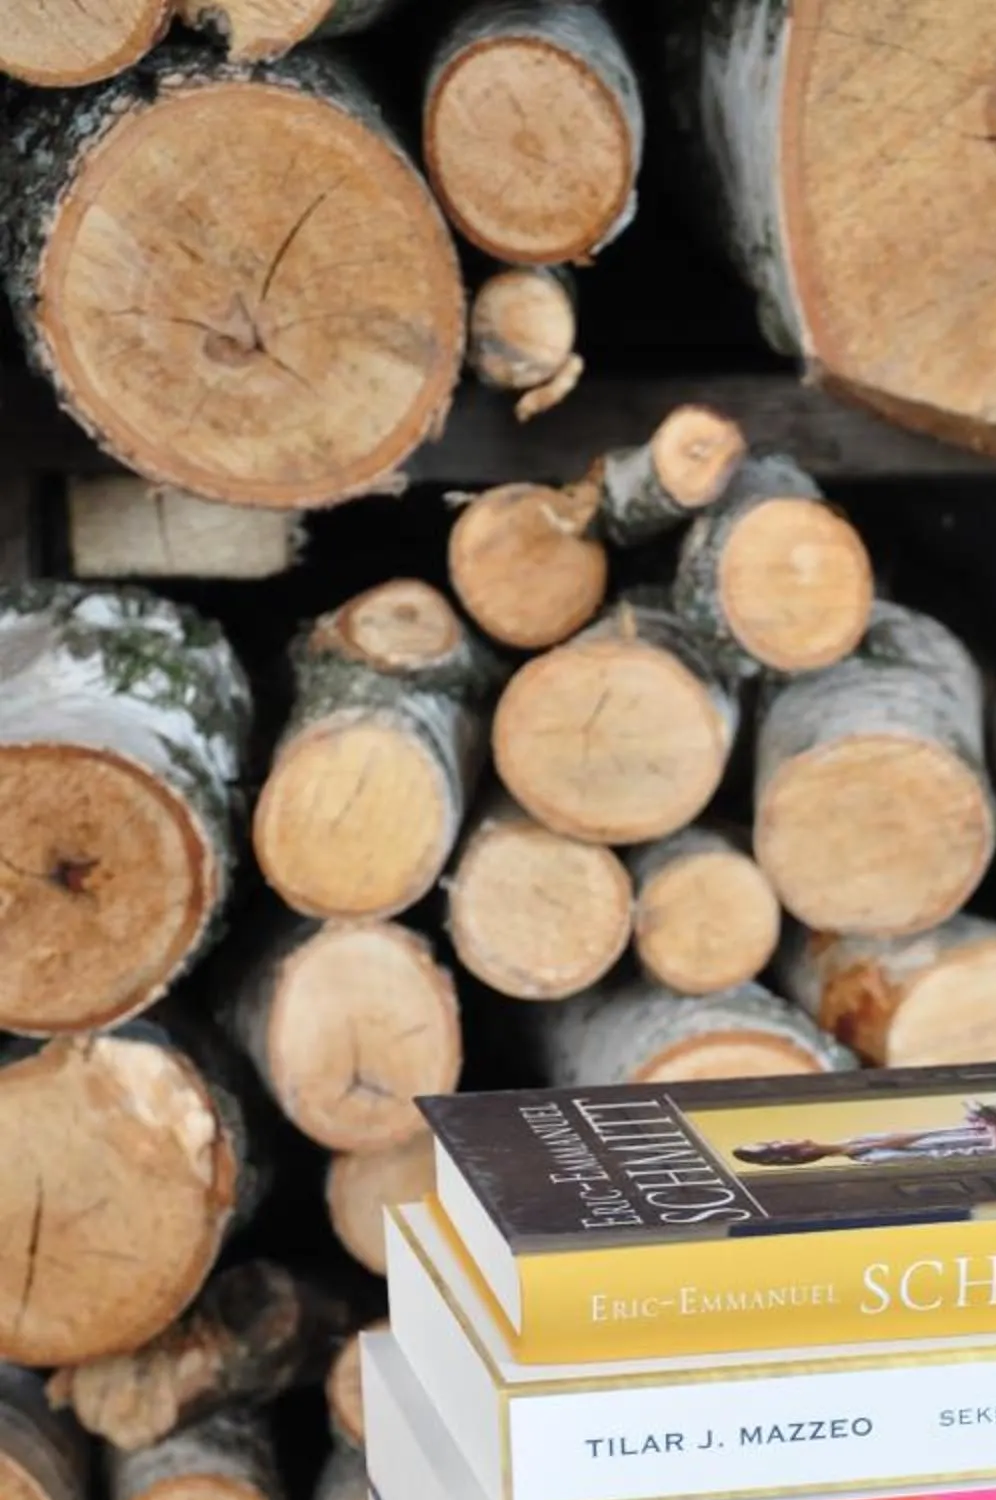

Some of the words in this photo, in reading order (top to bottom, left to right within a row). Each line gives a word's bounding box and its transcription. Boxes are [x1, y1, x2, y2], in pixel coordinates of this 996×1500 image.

[571, 1098, 752, 1224] SCHMITT
[591, 1283, 840, 1322] ERIC-EMMANUEL
[585, 1432, 685, 1458] TILAR
[697, 1429, 725, 1450] J.
[739, 1416, 873, 1446] MAZZEO
